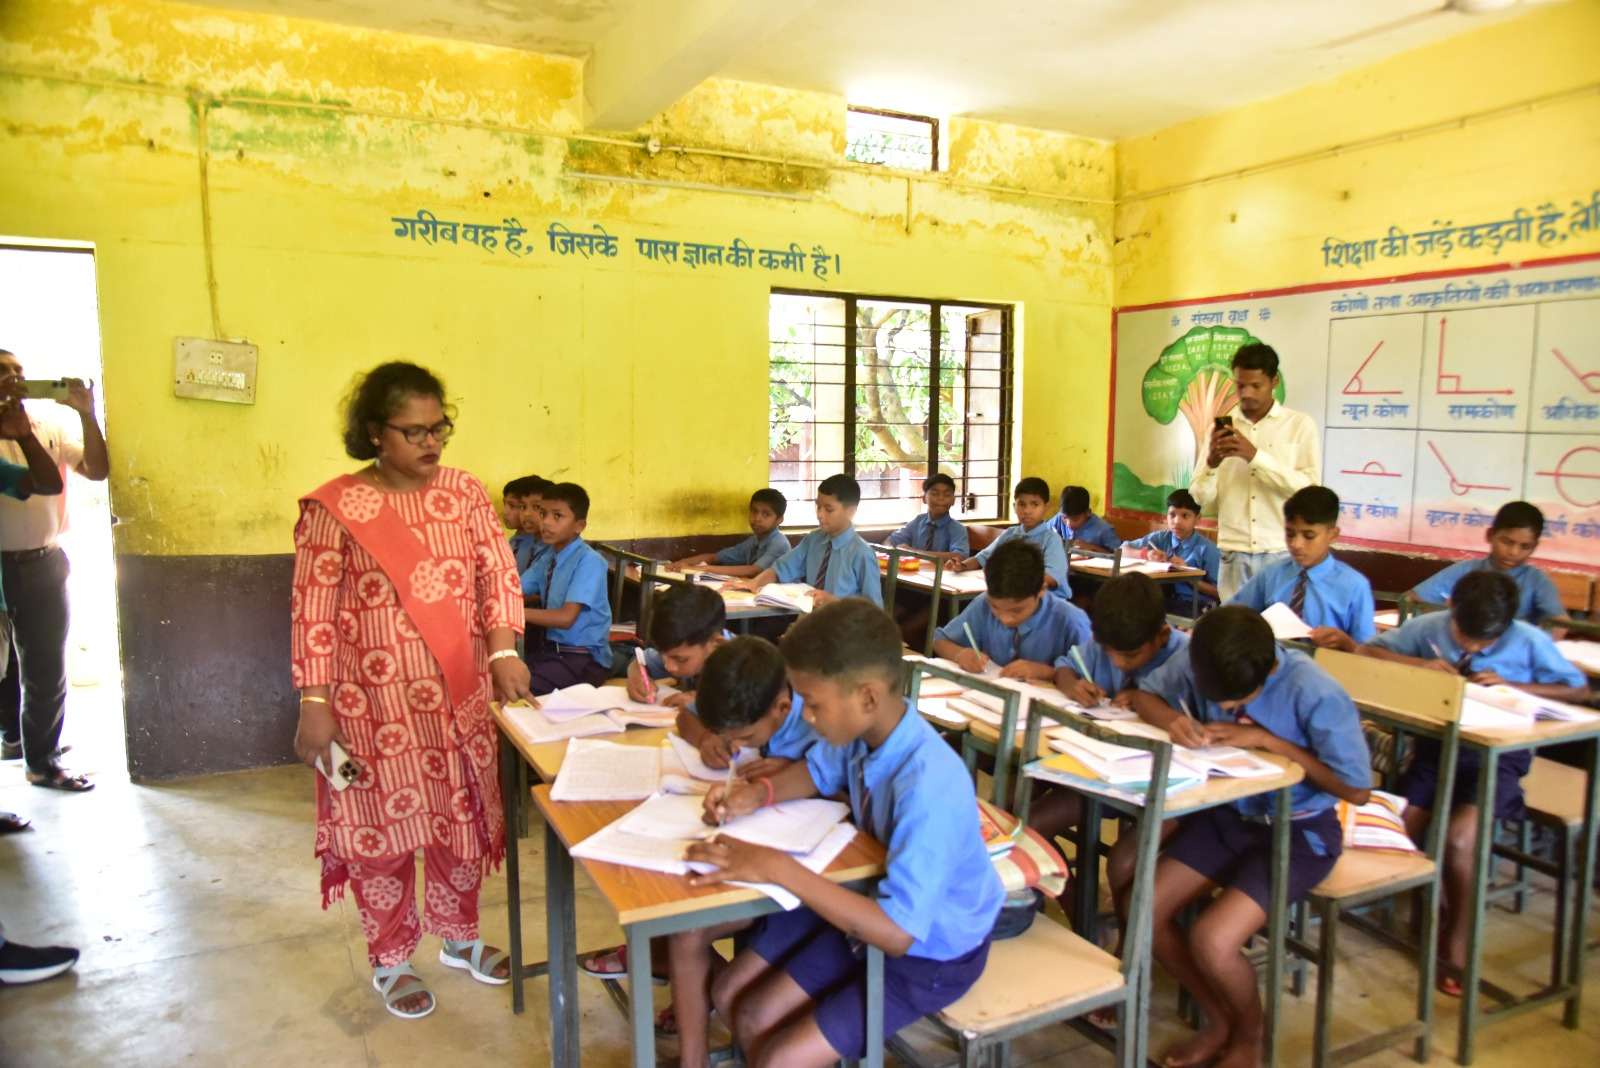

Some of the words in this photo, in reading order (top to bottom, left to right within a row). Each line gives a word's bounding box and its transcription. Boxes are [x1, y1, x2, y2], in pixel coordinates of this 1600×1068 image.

[391, 209, 458, 246] गरीब
[460, 225, 498, 260] वह
[547, 221, 618, 259] जिसके
[635, 237, 679, 263] पास
[681, 241, 725, 270] ज्ञान
[725, 239, 754, 268] की
[757, 243, 807, 273] कमी
[1321, 236, 1377, 269] शिक्षा
[1380, 226, 1410, 258] की
[1372, 398, 1409, 419] कोण
